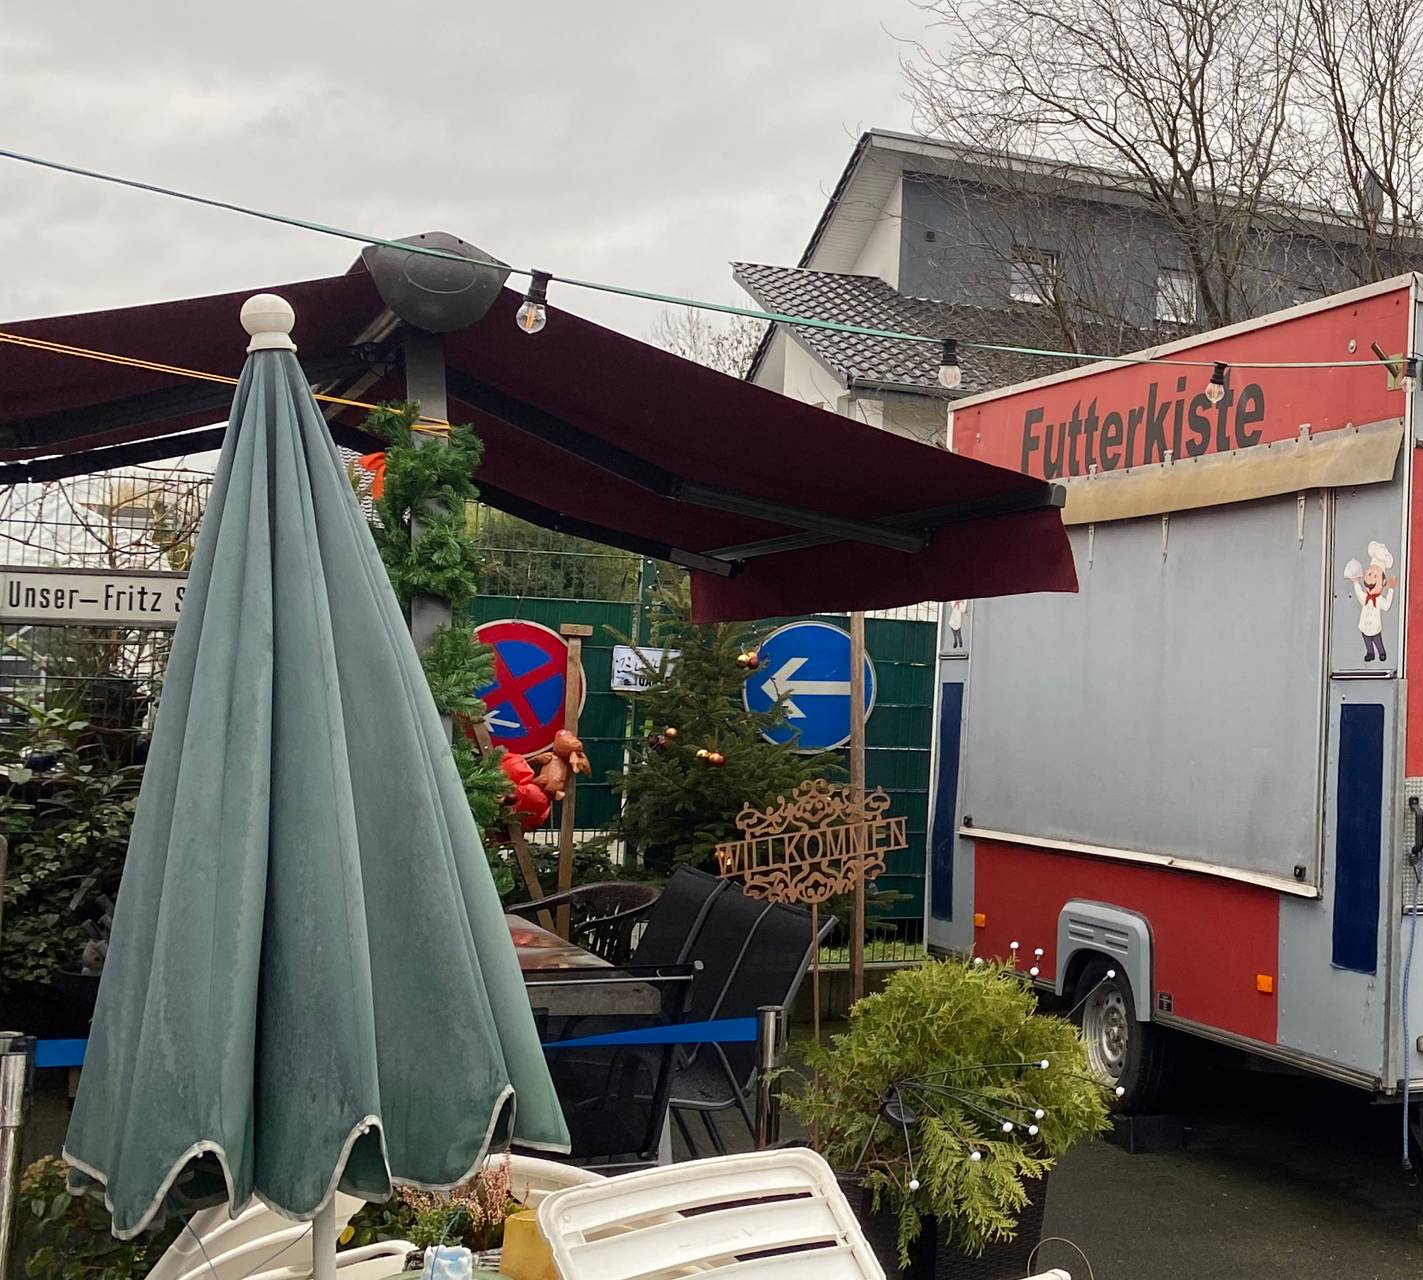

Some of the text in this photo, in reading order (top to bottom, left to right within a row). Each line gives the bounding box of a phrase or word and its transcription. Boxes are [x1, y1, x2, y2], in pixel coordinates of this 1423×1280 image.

[1021, 367, 1265, 480] Futterkiste
[9, 581, 186, 612] Unser-Fritz S
[715, 818, 908, 877] WILLKOMMEN
